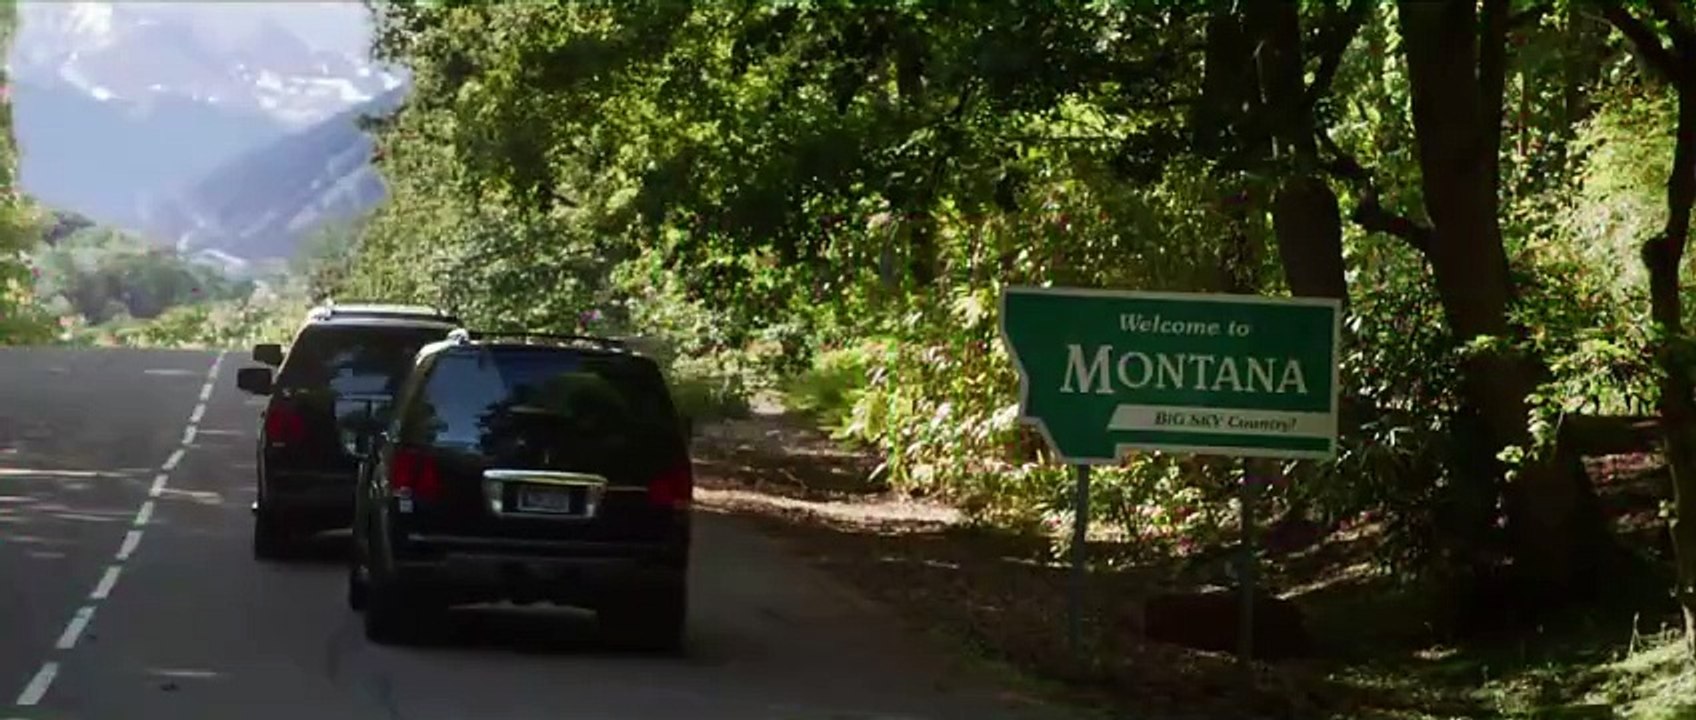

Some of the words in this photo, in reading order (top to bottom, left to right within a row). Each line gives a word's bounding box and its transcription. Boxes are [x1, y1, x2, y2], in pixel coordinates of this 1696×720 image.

[1119, 313, 1220, 336] Welcome
[1227, 318, 1250, 338] to
[1060, 343, 1308, 394] MONTANA
